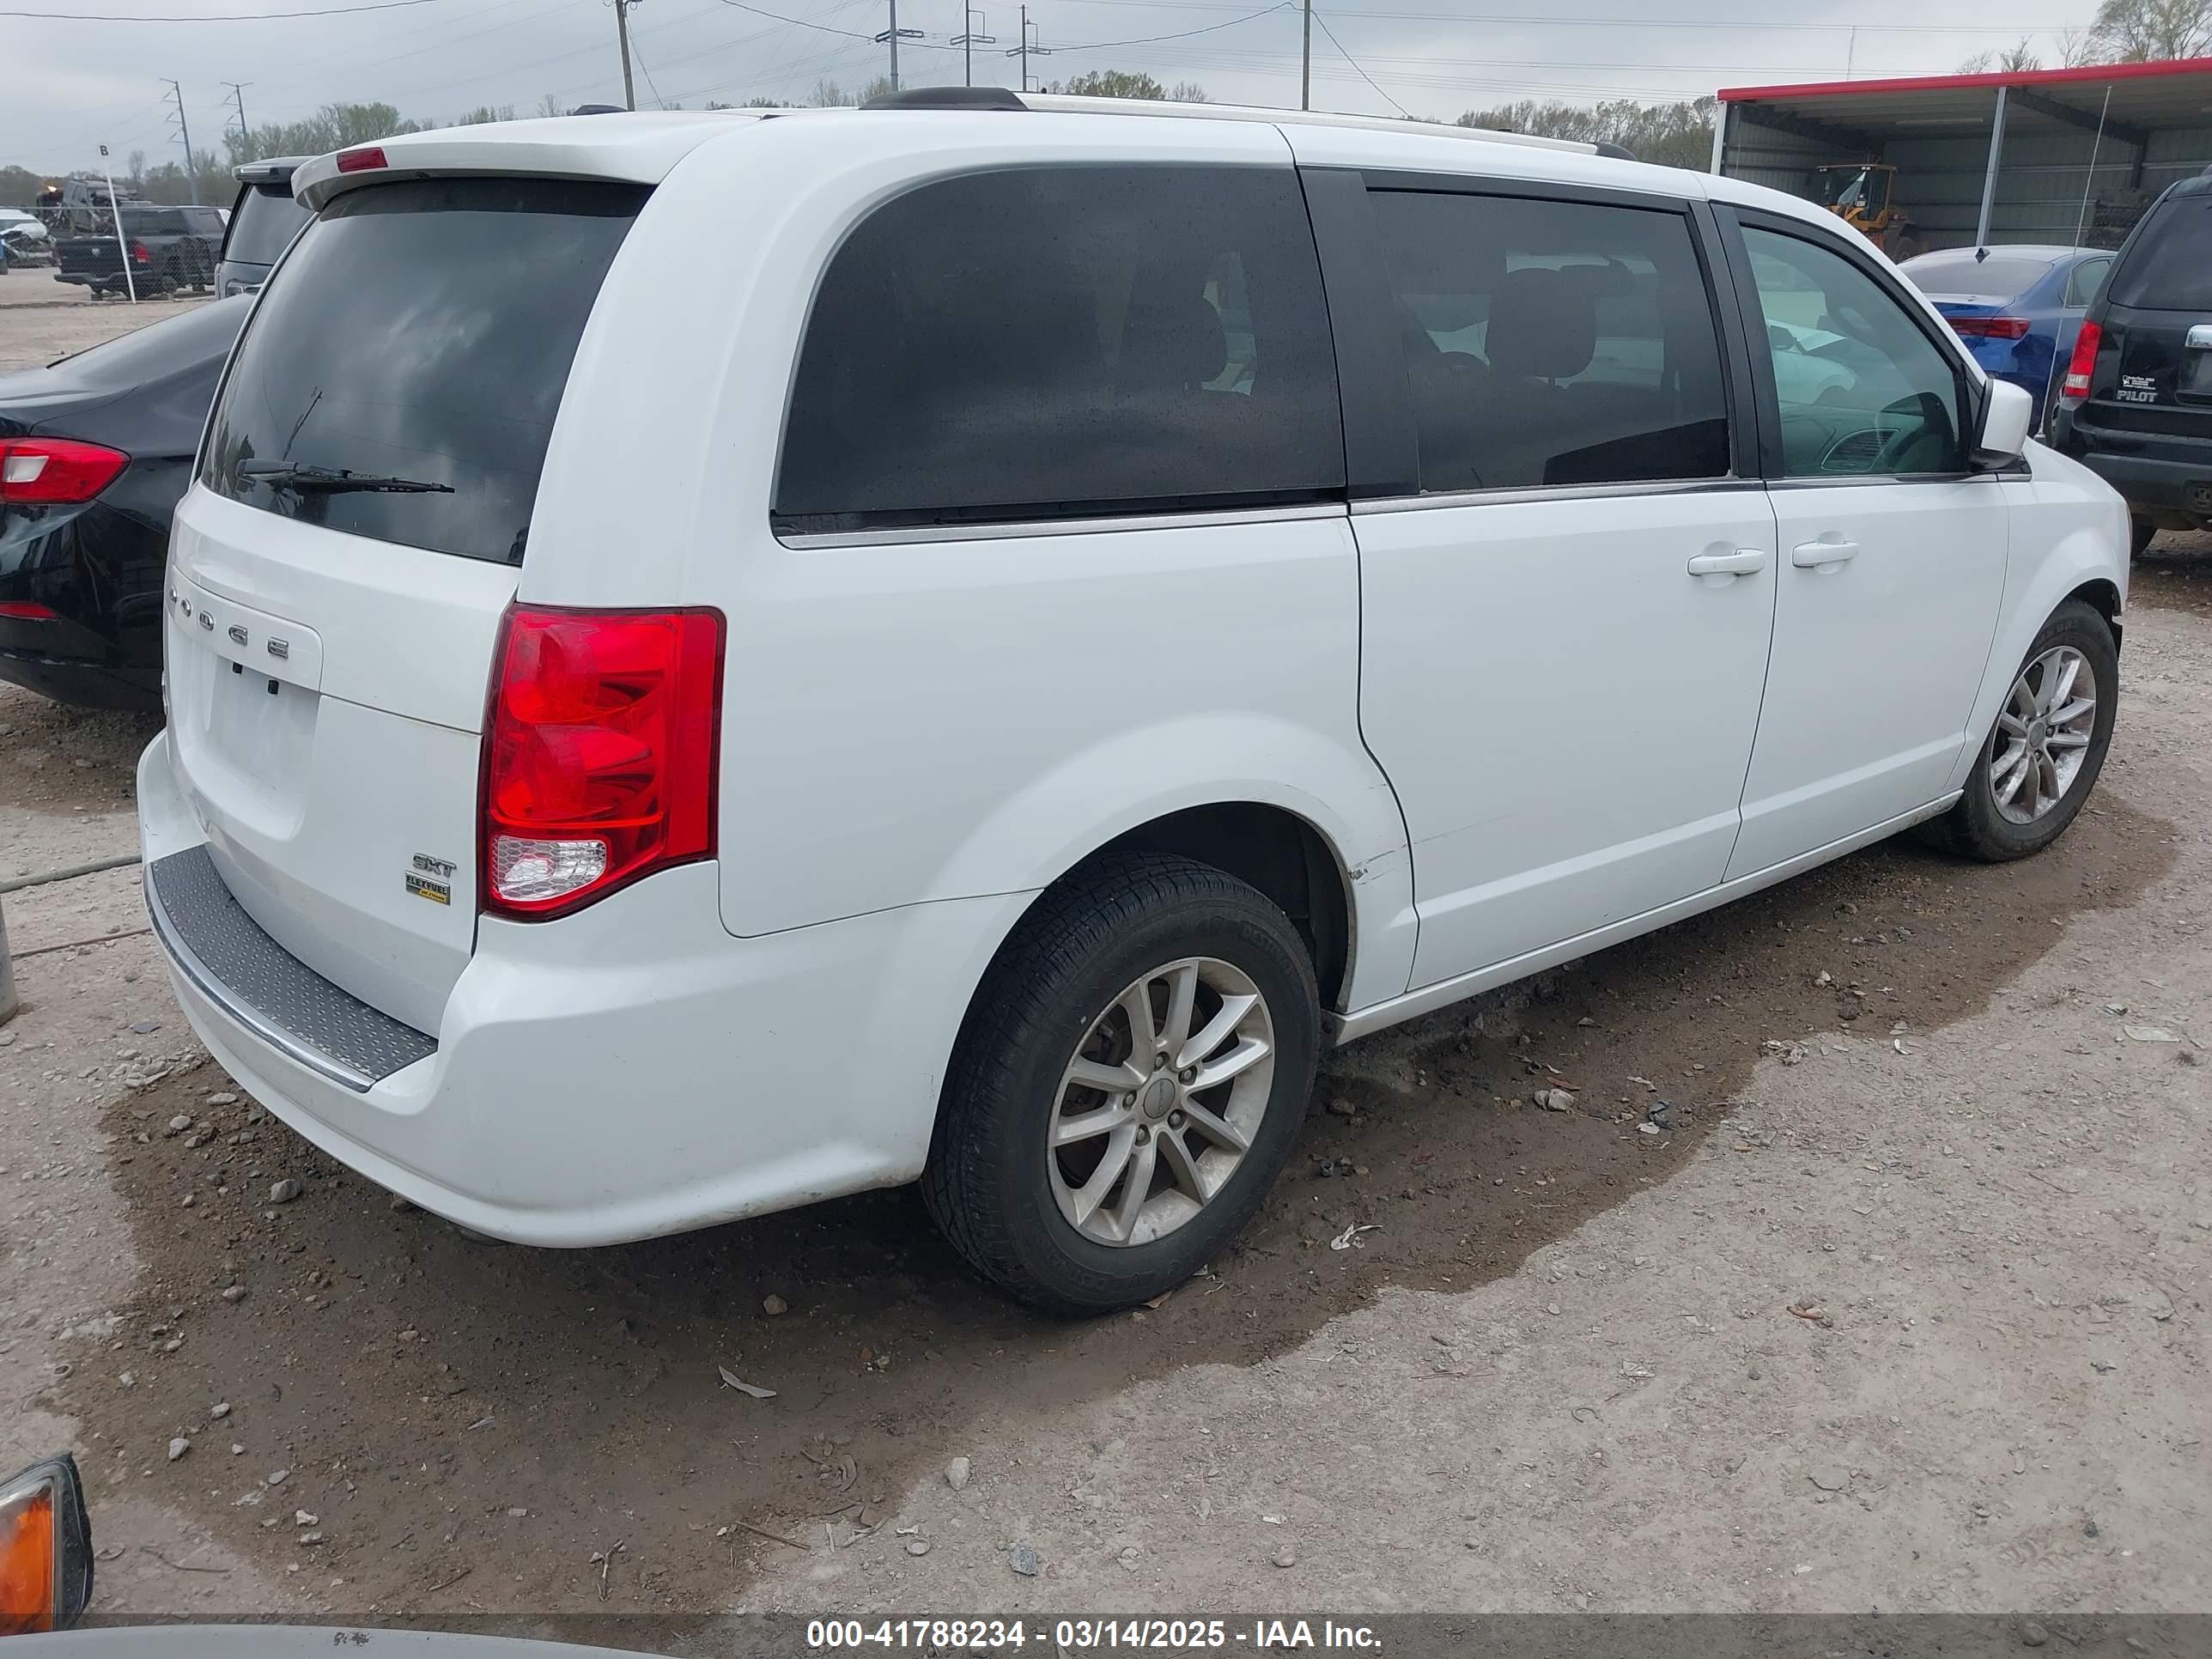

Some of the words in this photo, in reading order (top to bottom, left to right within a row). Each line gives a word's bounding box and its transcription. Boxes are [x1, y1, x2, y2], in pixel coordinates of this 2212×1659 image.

[99, 144, 109, 156] B
[2116, 389, 2158, 403] PILOT
[412, 852, 457, 878] SXT
